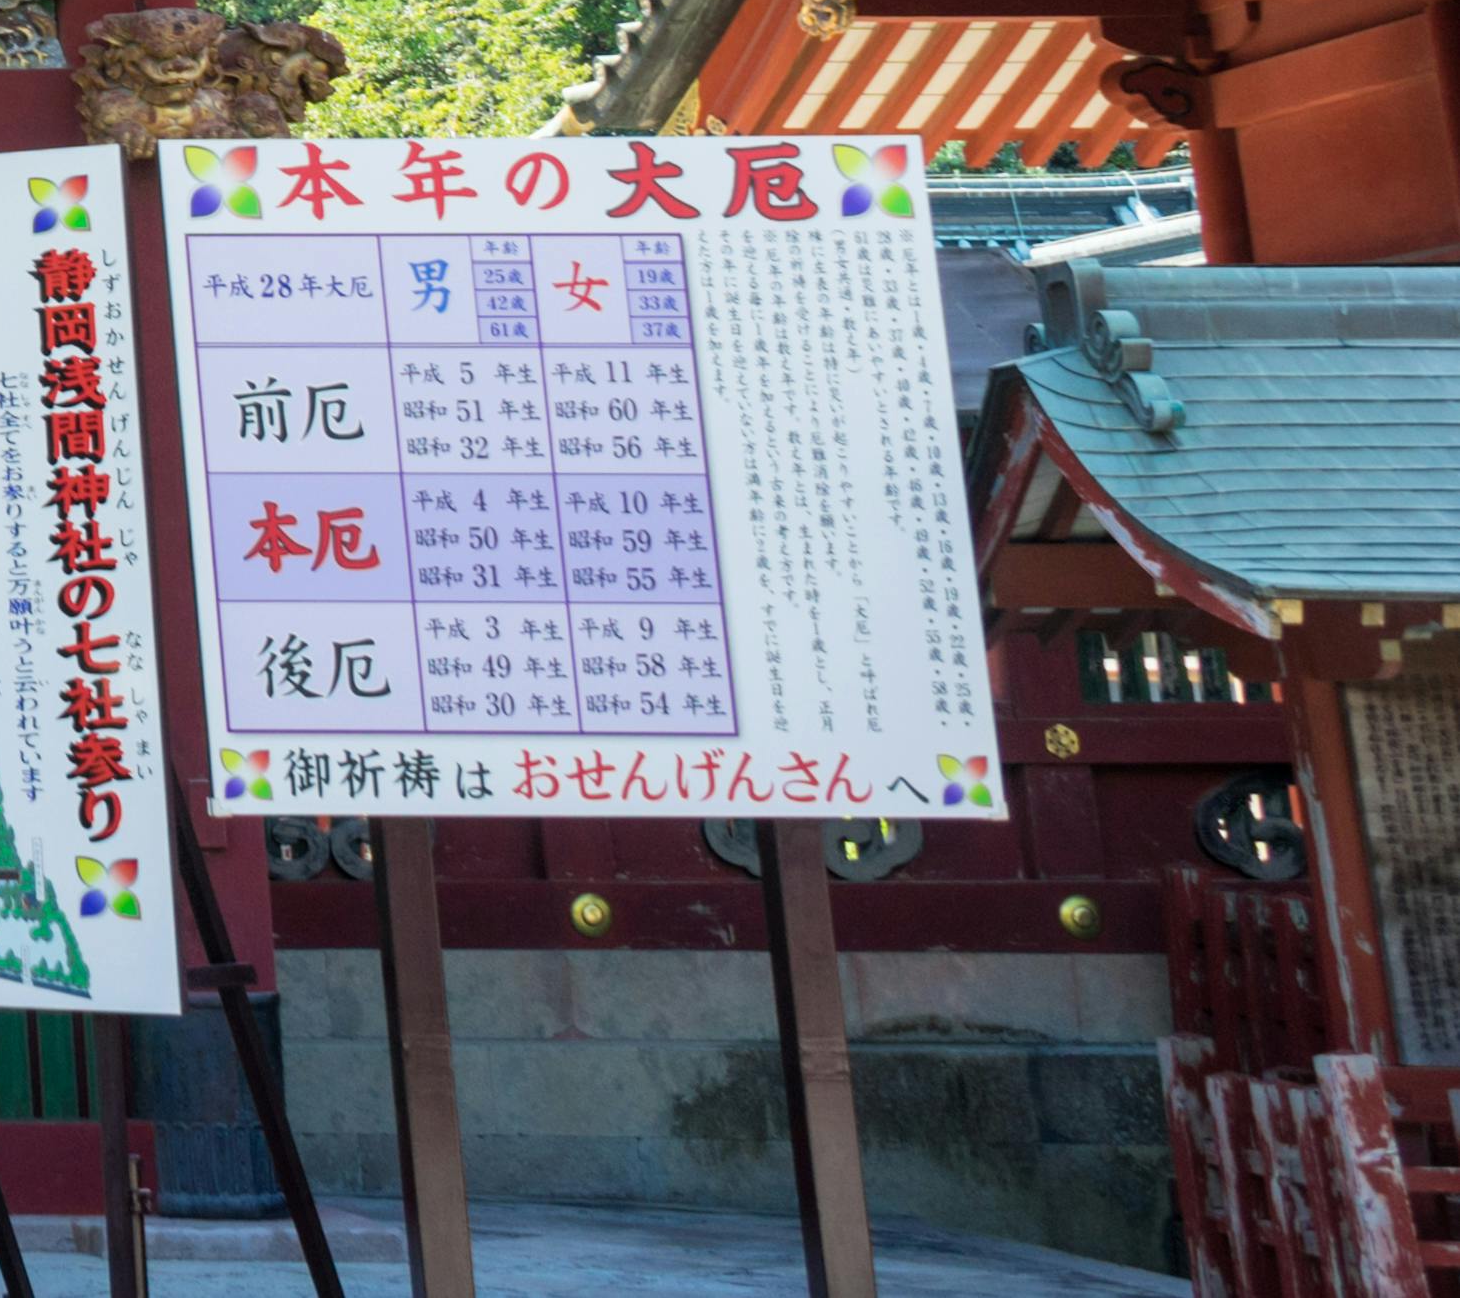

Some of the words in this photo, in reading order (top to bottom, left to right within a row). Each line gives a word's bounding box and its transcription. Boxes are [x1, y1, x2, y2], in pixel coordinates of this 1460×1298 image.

[276, 141, 820, 222] 本年の大厄
[483, 240, 520, 255] 年齢
[635, 240, 672, 255] 年齢
[203, 273, 374, 300] 平成28年大厄
[408, 258, 451, 314] 男
[483, 269, 525, 285] 25歳
[552, 260, 610, 313] 女
[637, 268, 675, 284] 19歳
[486, 296, 528, 312] 42歳
[638, 295, 679, 312] 33歳
[489, 322, 530, 339] 61歳
[642, 322, 683, 339] 37歳
[233, 375, 365, 444] 前厄
[27, 248, 136, 844] 静岡浅間神社の七社参り
[243, 499, 381, 573] 本厄
[258, 633, 392, 699] 後厄
